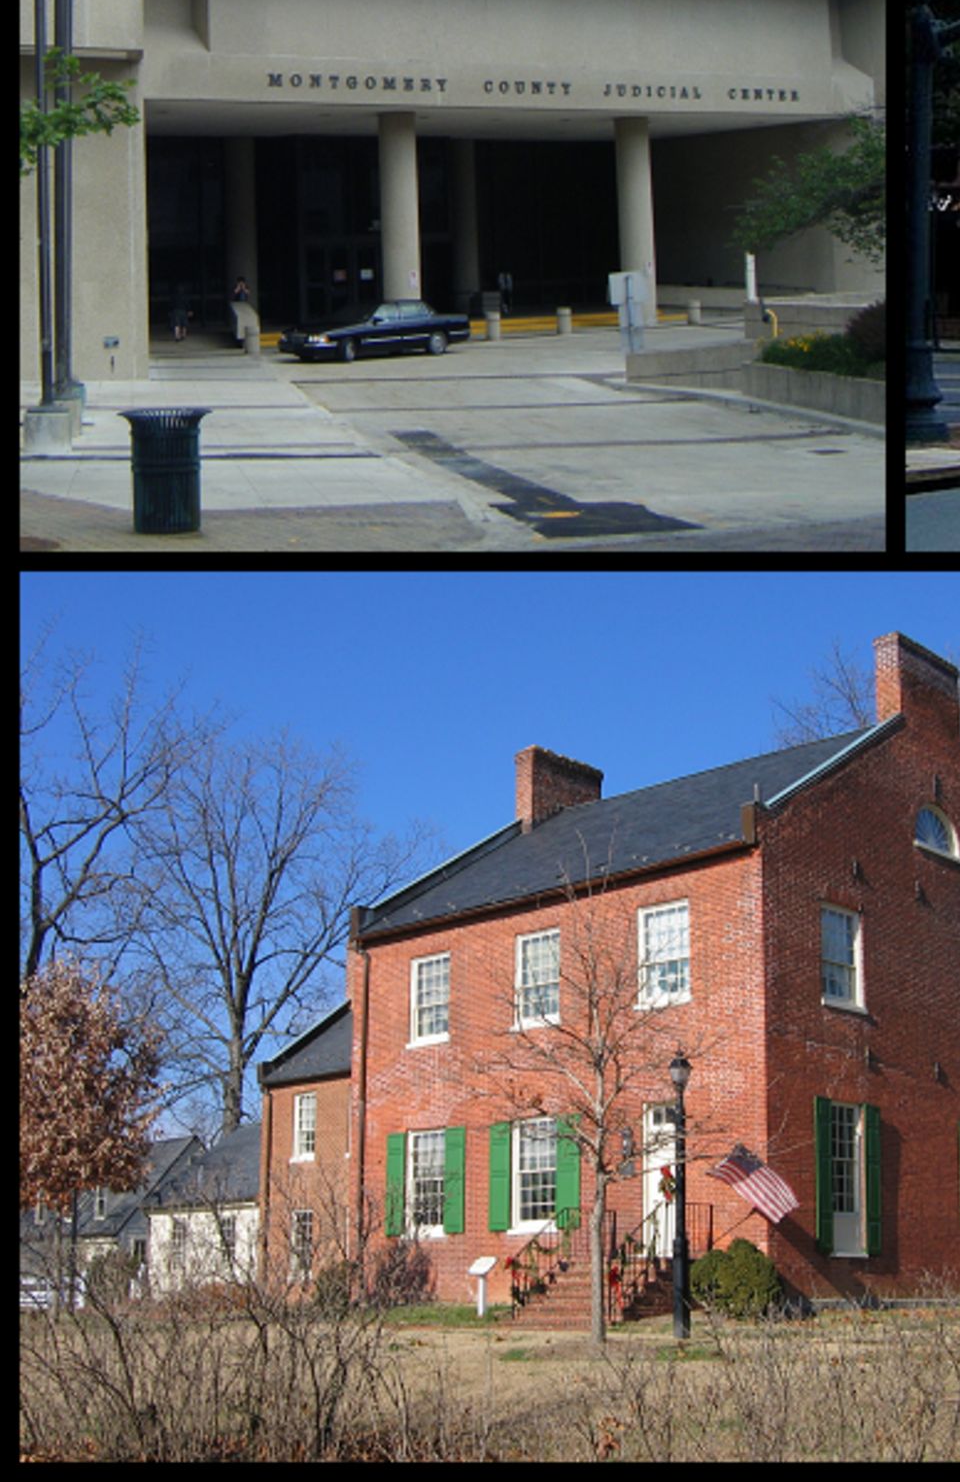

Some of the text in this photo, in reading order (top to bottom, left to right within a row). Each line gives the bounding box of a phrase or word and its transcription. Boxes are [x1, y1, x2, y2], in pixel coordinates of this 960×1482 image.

[267, 73, 799, 102] MONTGOMERY COUNTY JUDICIAL CENTER
